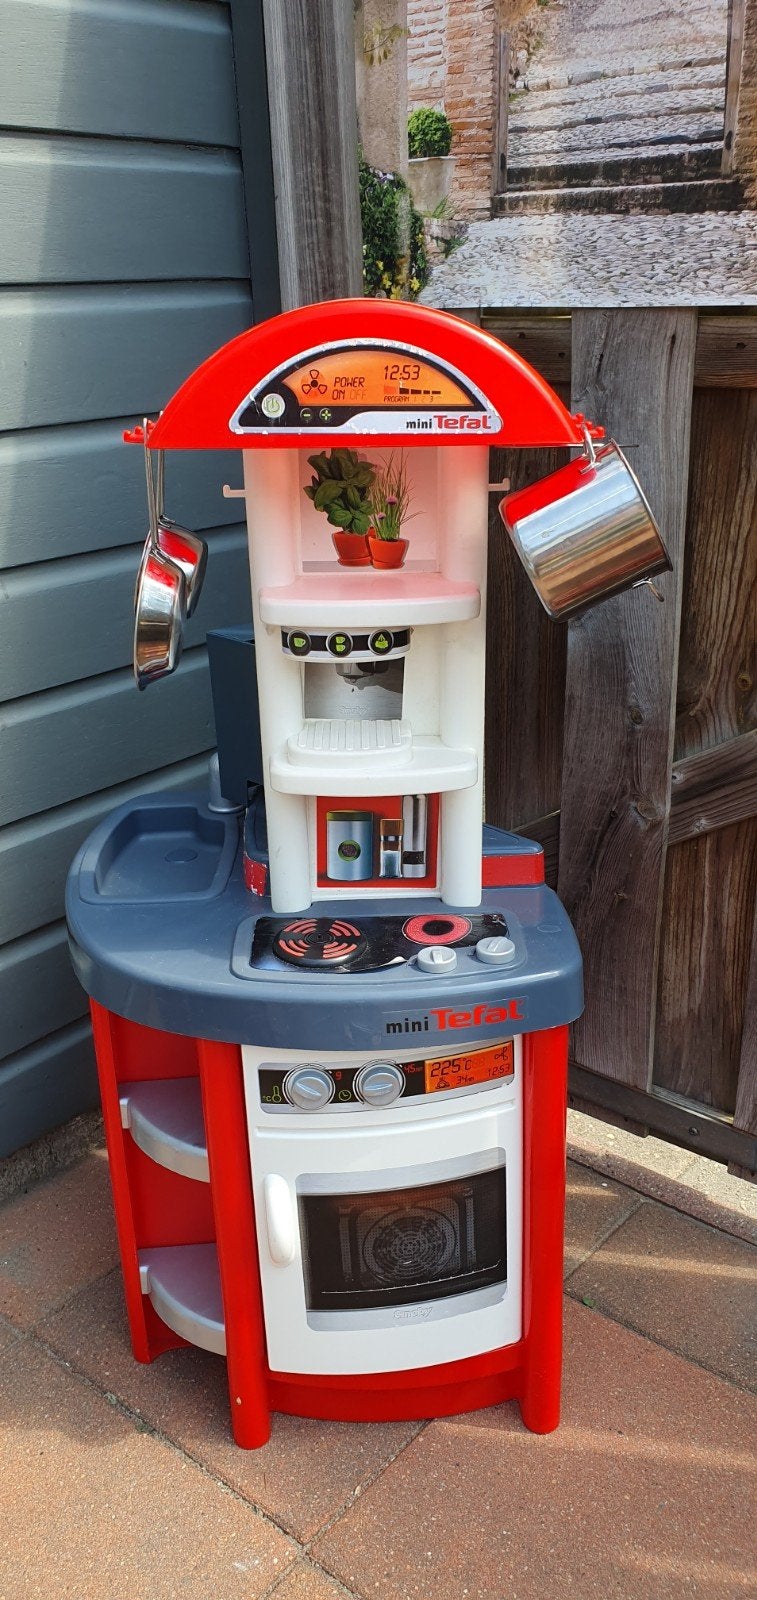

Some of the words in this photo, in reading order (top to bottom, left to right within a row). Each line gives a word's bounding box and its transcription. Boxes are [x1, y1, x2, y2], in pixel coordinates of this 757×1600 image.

[384, 365, 420, 380] 12:53
[334, 376, 365, 388] POWER
[332, 389, 345, 400] ON
[406, 418, 432, 429] mini
[433, 415, 491, 429] Tefal
[386, 1016, 429, 1033] mini
[430, 999, 525, 1031] Tefal
